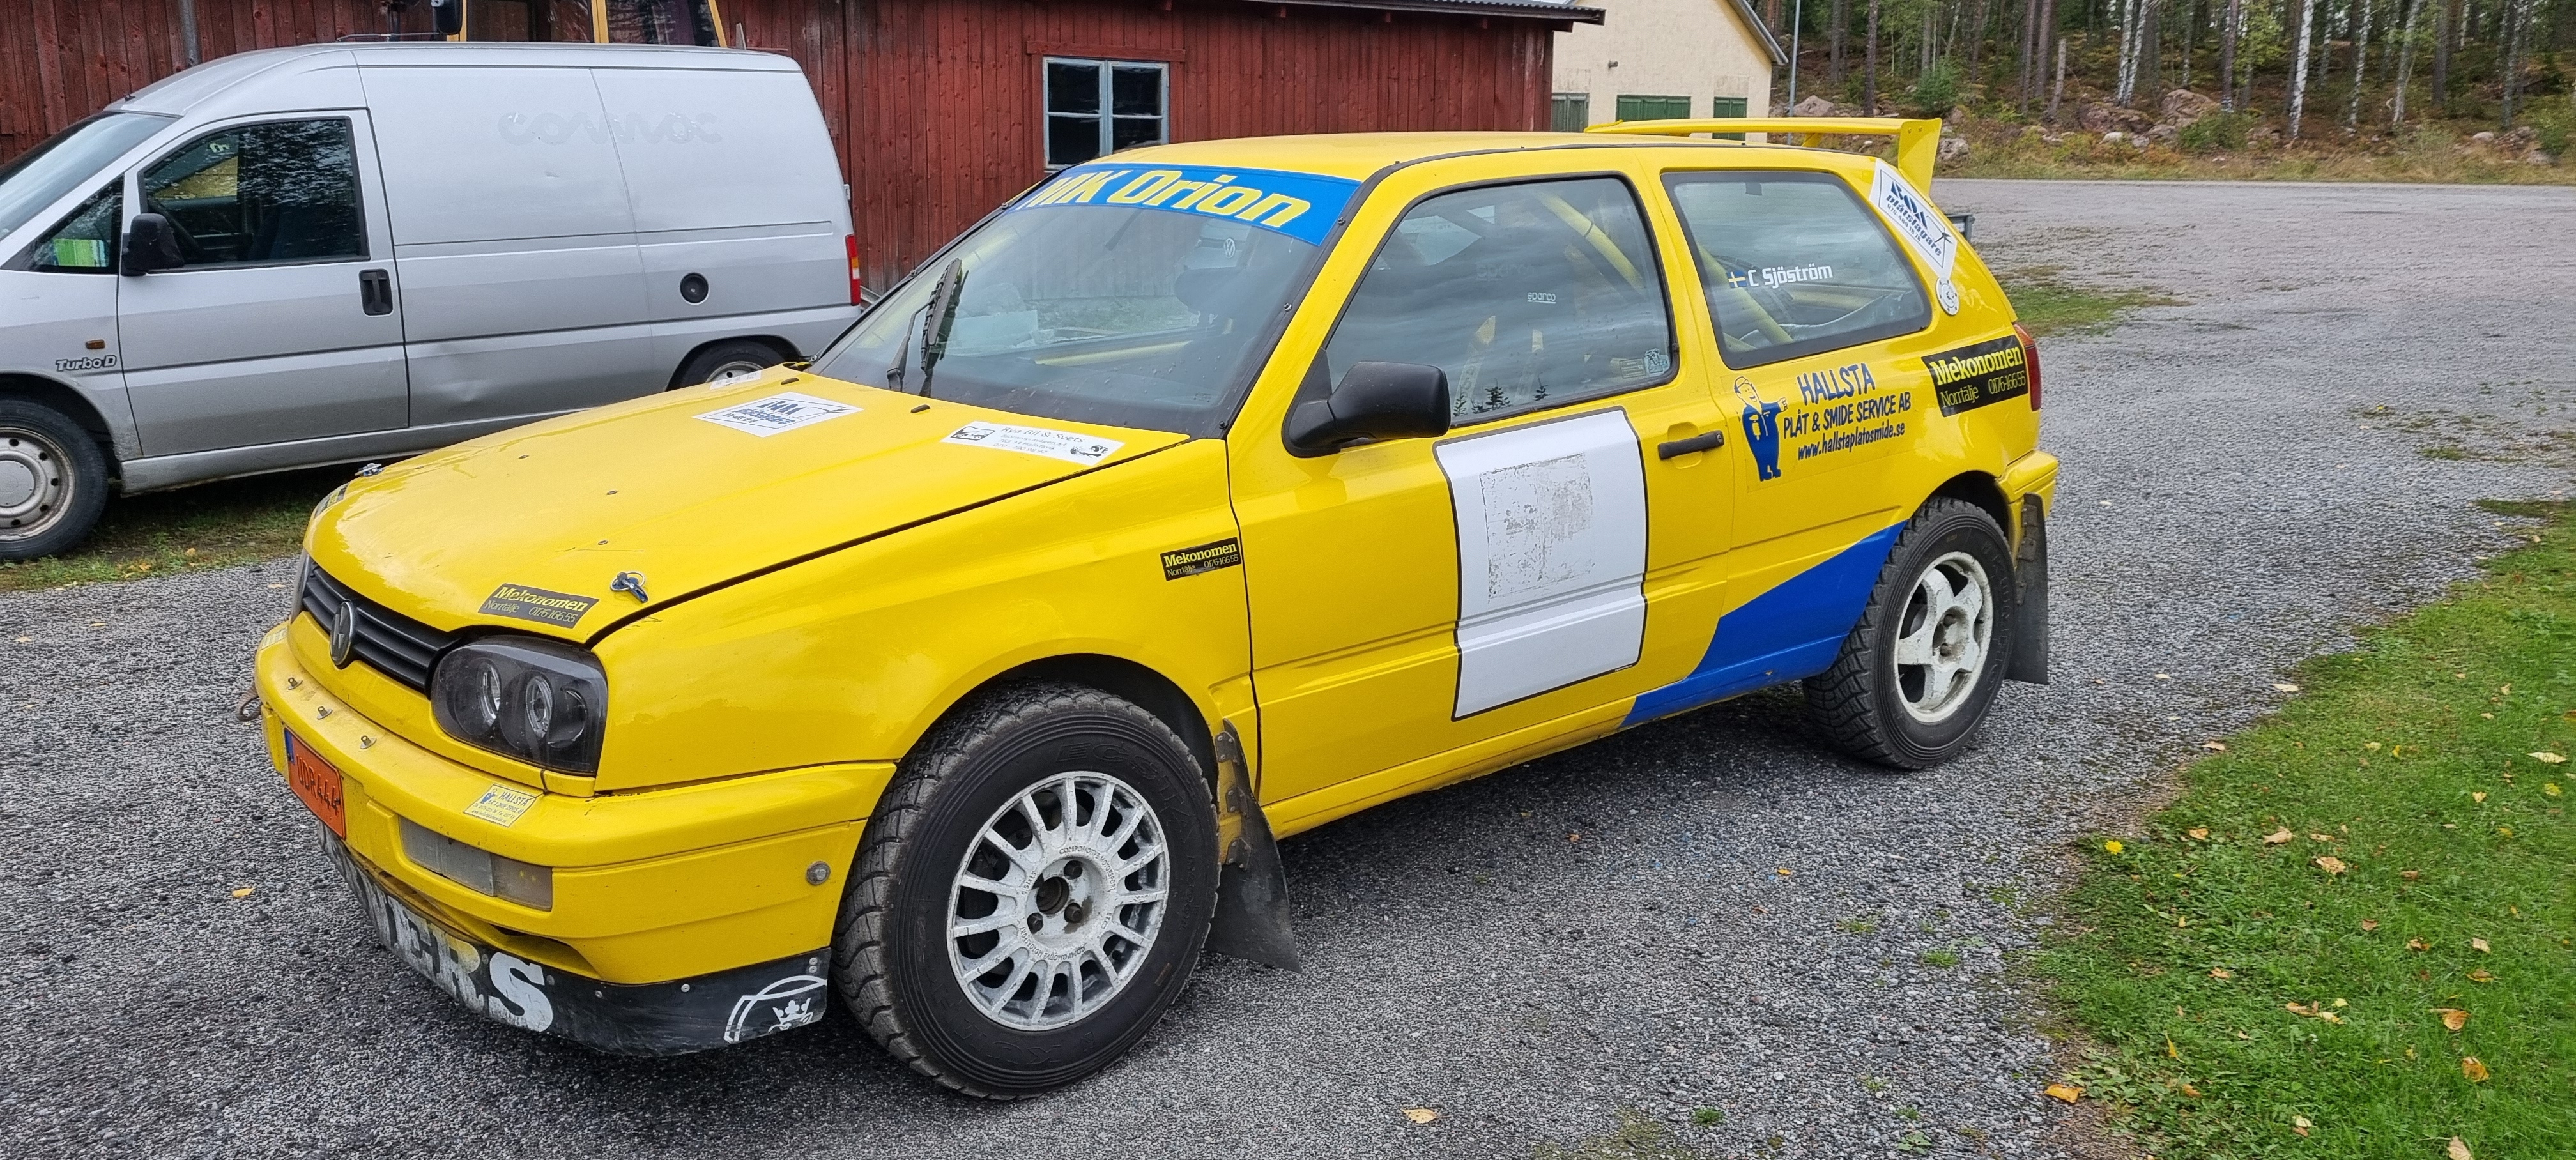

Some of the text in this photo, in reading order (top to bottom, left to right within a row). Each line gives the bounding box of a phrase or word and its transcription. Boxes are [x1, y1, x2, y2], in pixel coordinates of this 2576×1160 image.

[1016, 170, 1310, 227] MK Orion
[1748, 263, 1833, 289] C Sjöström
[1528, 292, 1556, 303] sparco
[56, 355, 117, 372] Turbo D
[1929, 347, 2023, 385] Mekonomen
[1797, 363, 1876, 406] HALLSTA
[1940, 385, 1979, 408] Norrtälje
[1784, 392, 1911, 439] PLÅT & SMIDE SERVICE AB
[1053, 434, 1085, 442] Svets
[1798, 419, 1905, 460] www.hallstaplatosmide.se
[1163, 544, 1237, 567] Mekonomen
[1167, 565, 1195, 577] Norrtälje
[484, 600, 520, 614] Norrtälje
[493, 586, 588, 612] Mekonomen
[498, 791, 530, 806] HALLSTA
